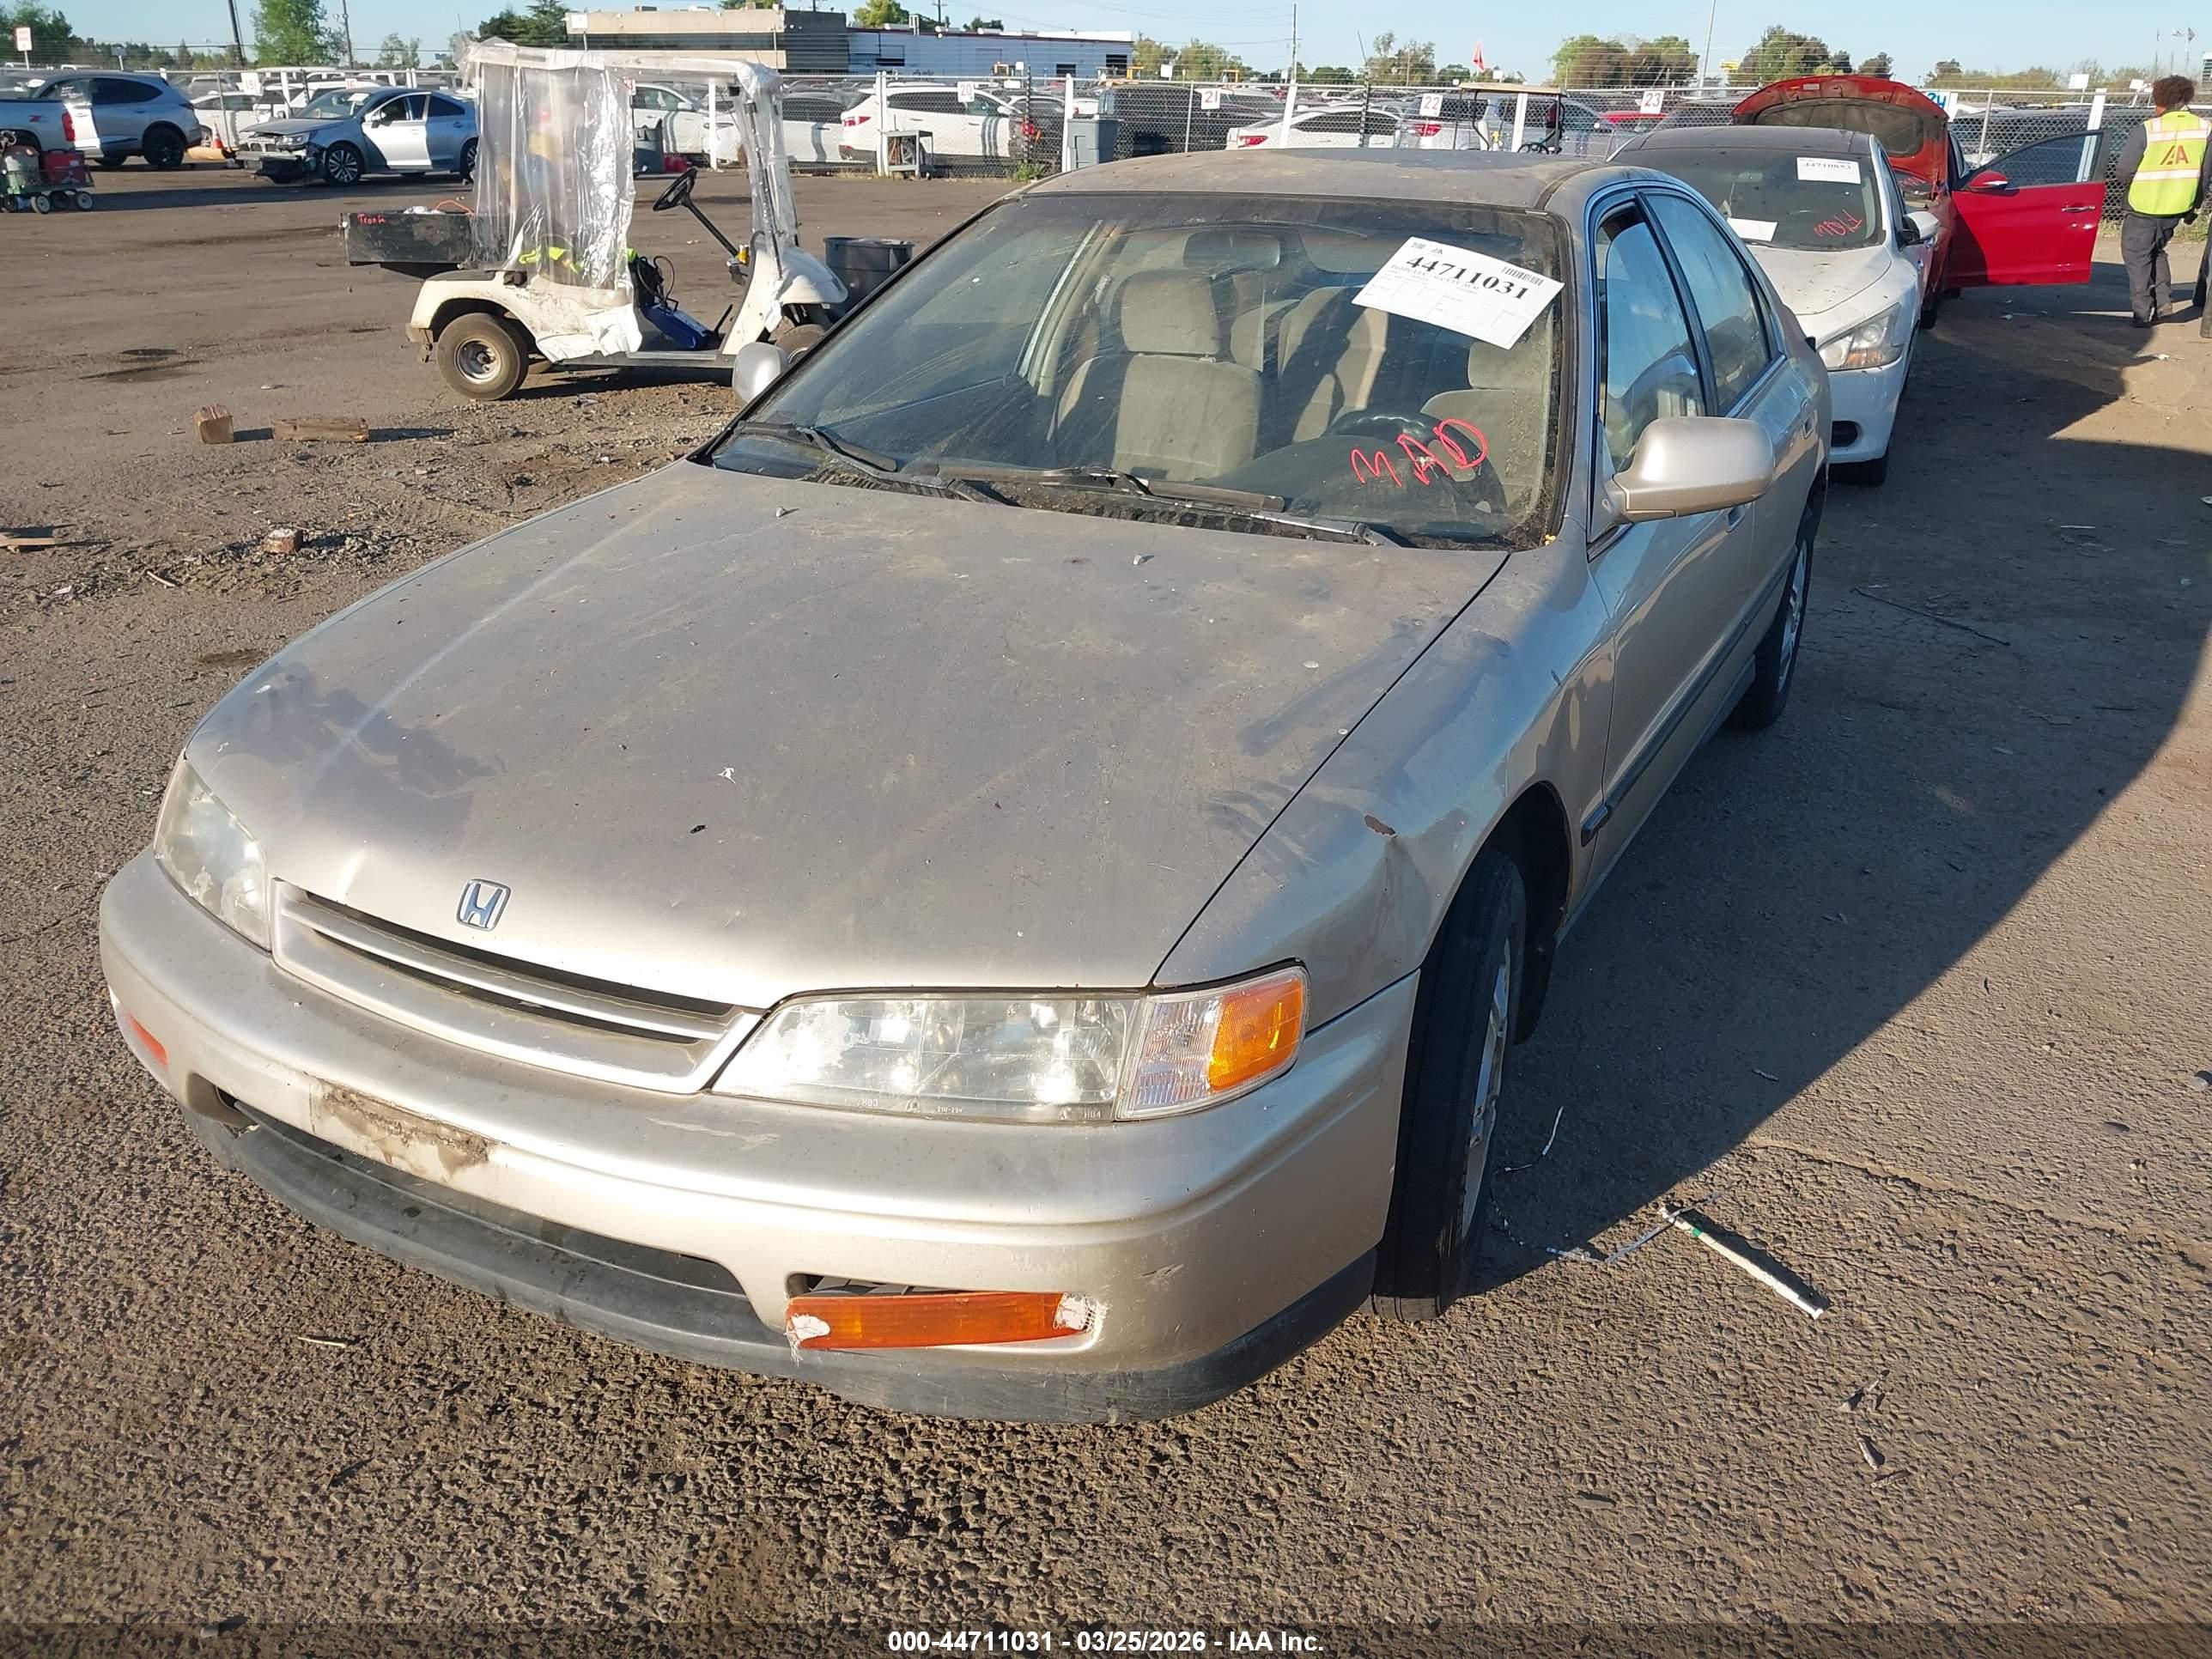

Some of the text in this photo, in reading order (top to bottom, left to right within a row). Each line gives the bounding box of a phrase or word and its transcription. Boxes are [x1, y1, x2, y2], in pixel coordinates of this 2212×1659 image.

[960, 83, 972, 96] 20
[1205, 90, 1218, 103] 21
[1424, 95, 1440, 110] 22
[1644, 92, 1662, 107] 23
[1407, 256, 1529, 300] 44711031
